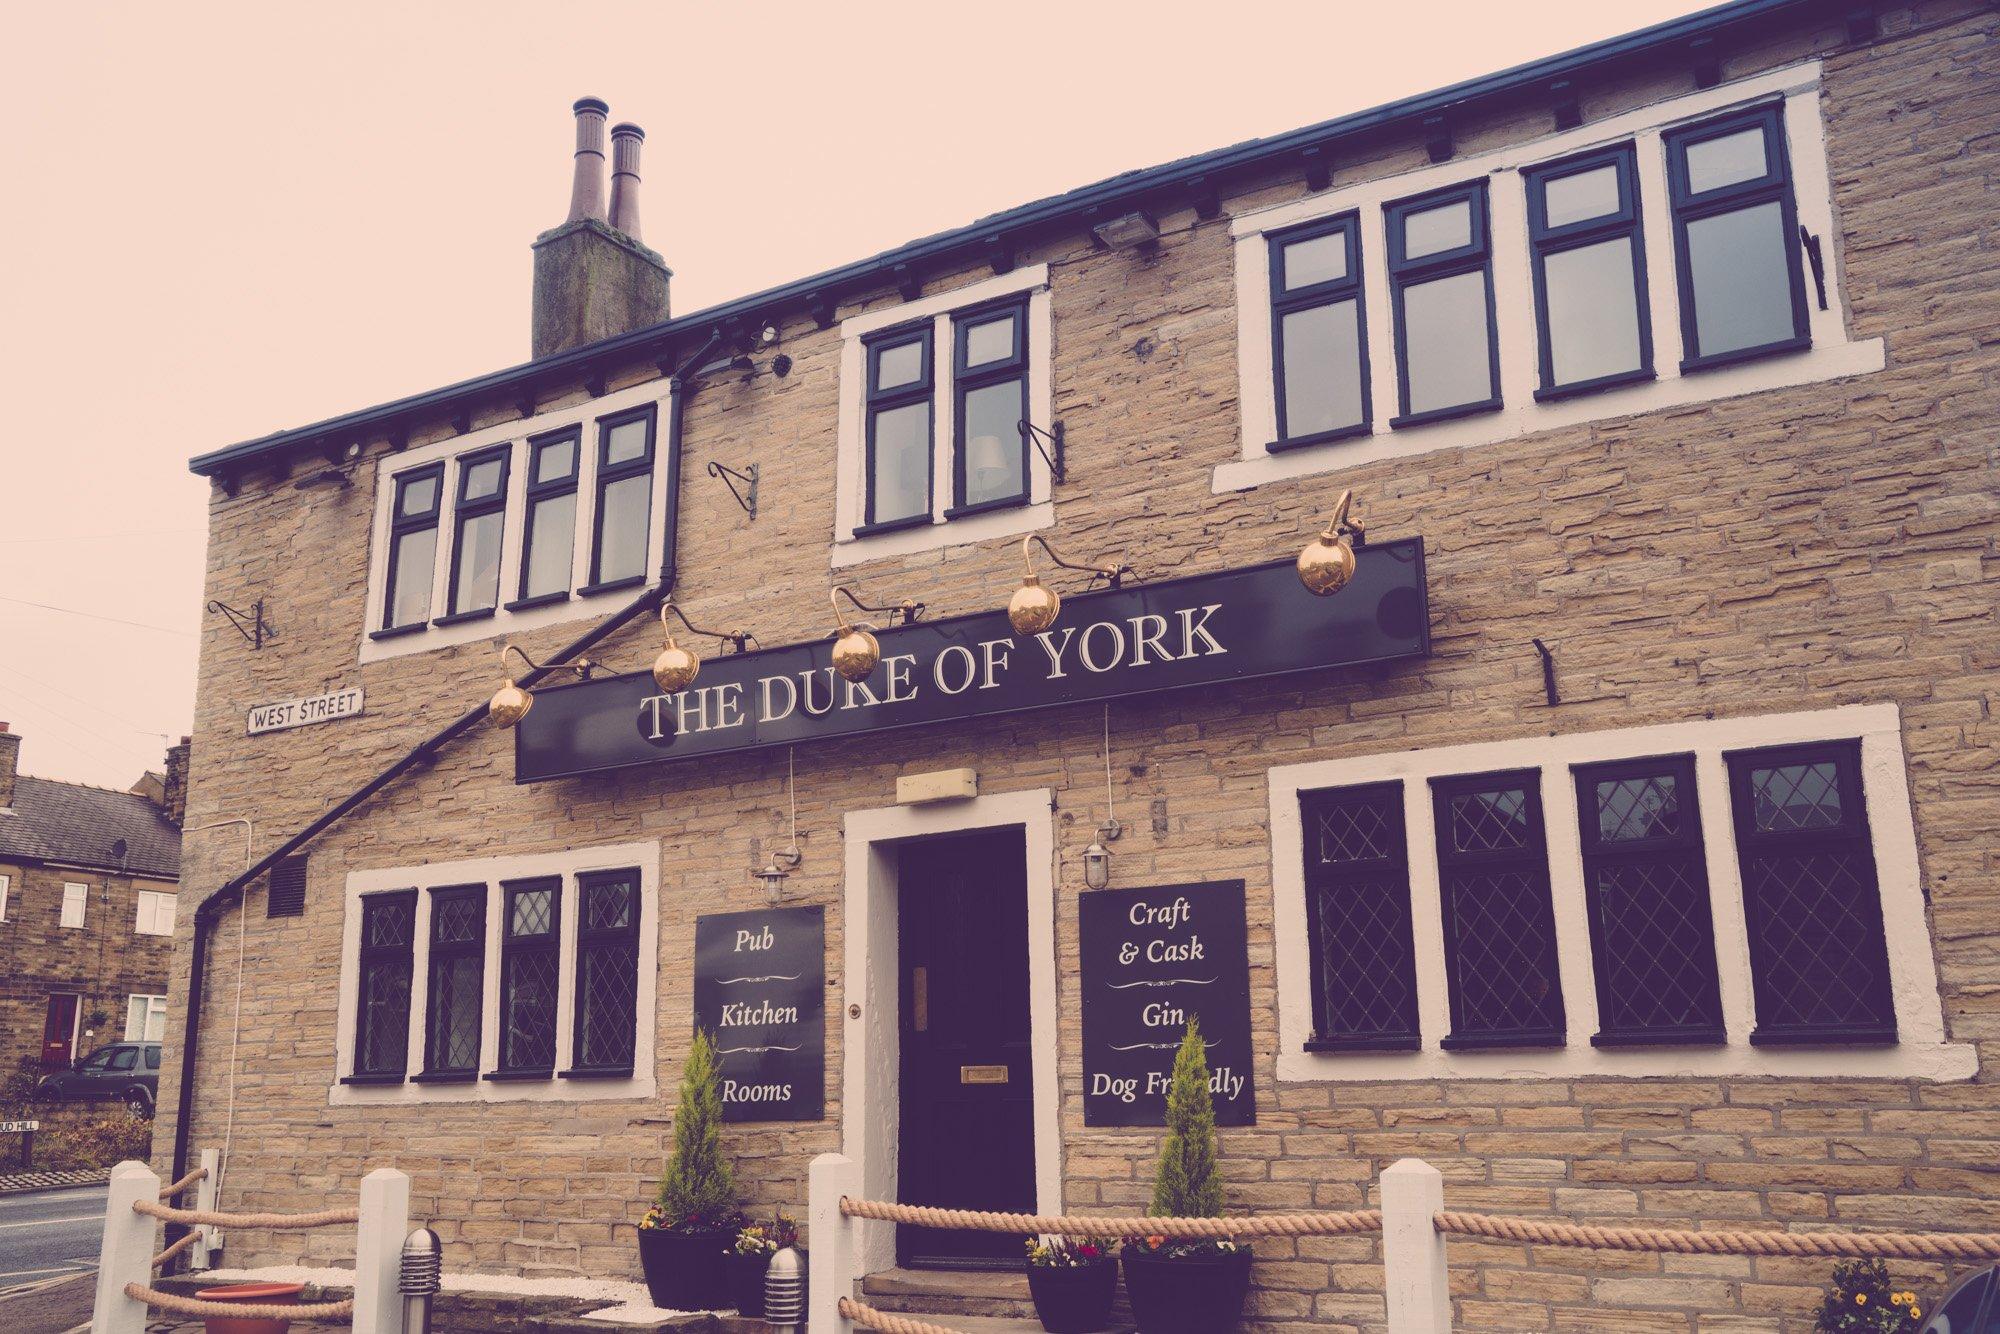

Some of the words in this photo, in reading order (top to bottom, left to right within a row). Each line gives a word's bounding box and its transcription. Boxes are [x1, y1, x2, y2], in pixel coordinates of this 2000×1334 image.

[639, 682, 745, 739] THE
[933, 637, 1016, 695] OF
[1033, 603, 1228, 680] YORK
[254, 705, 295, 728] WEST
[300, 693, 357, 721] STREET
[1129, 897, 1191, 930] Craft
[734, 925, 775, 952] Pub
[1118, 942, 1140, 965] &
[1146, 935, 1205, 963] Cask
[719, 1000, 798, 1027] Kitchen
[1142, 1001, 1185, 1027] Gin
[721, 1080, 792, 1103] Rooms
[1091, 1073, 1138, 1103] Dog
[1145, 1067, 1245, 1101] Frdly
[17, 1121, 34, 1130] HILL
